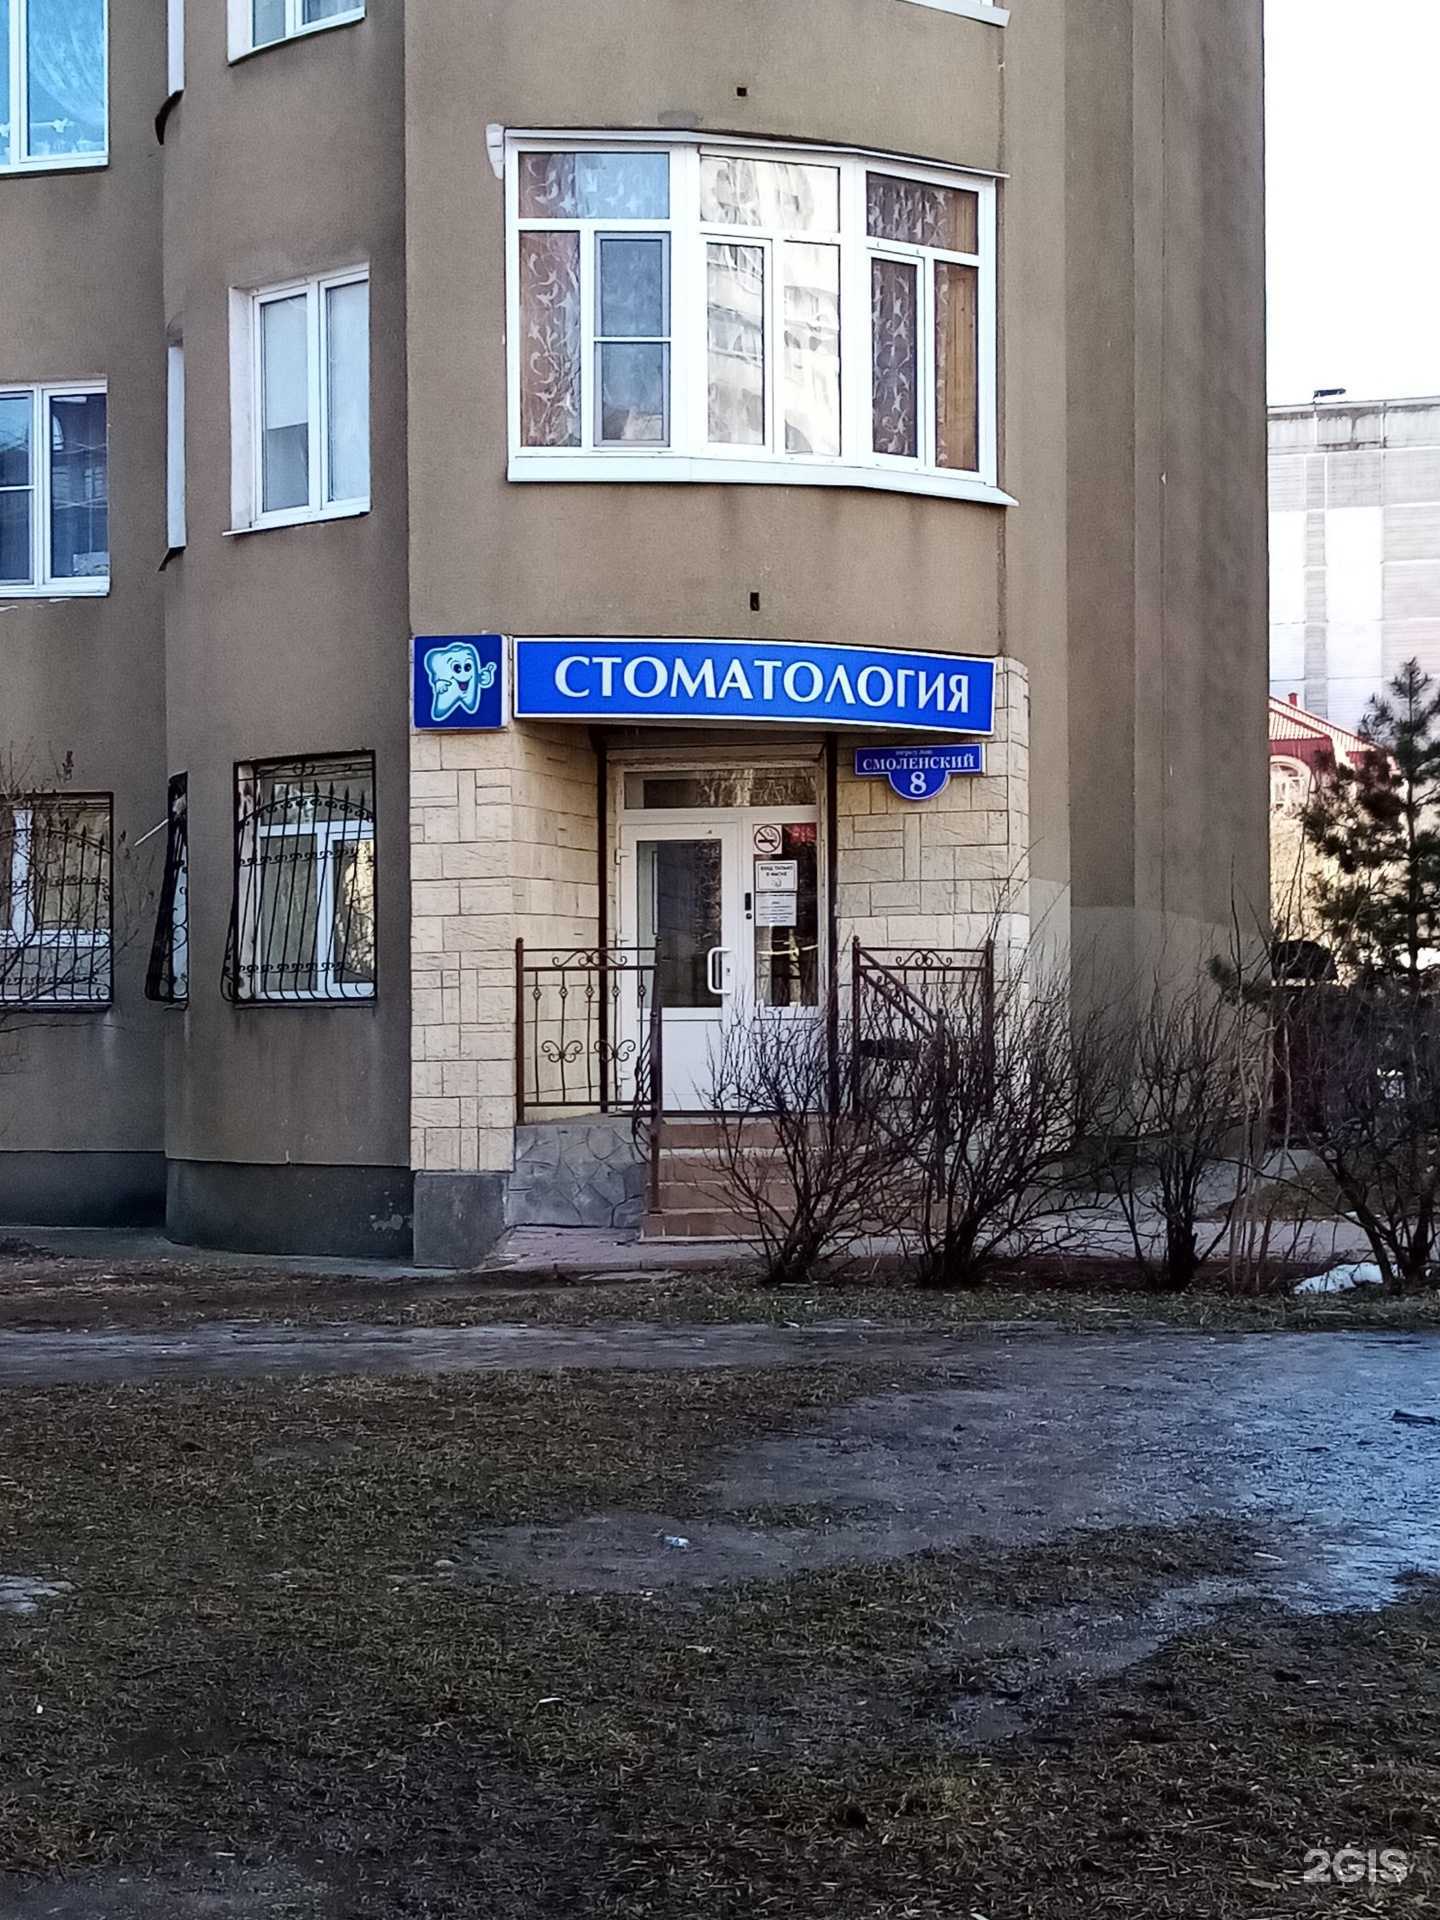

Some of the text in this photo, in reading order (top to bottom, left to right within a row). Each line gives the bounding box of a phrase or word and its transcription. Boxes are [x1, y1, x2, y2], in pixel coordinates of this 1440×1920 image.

[554, 655, 969, 714] СТОМАТОЛОГИЯ
[862, 753, 975, 770] СМОЛЕНСКИЙ
[909, 771, 927, 794] 8
